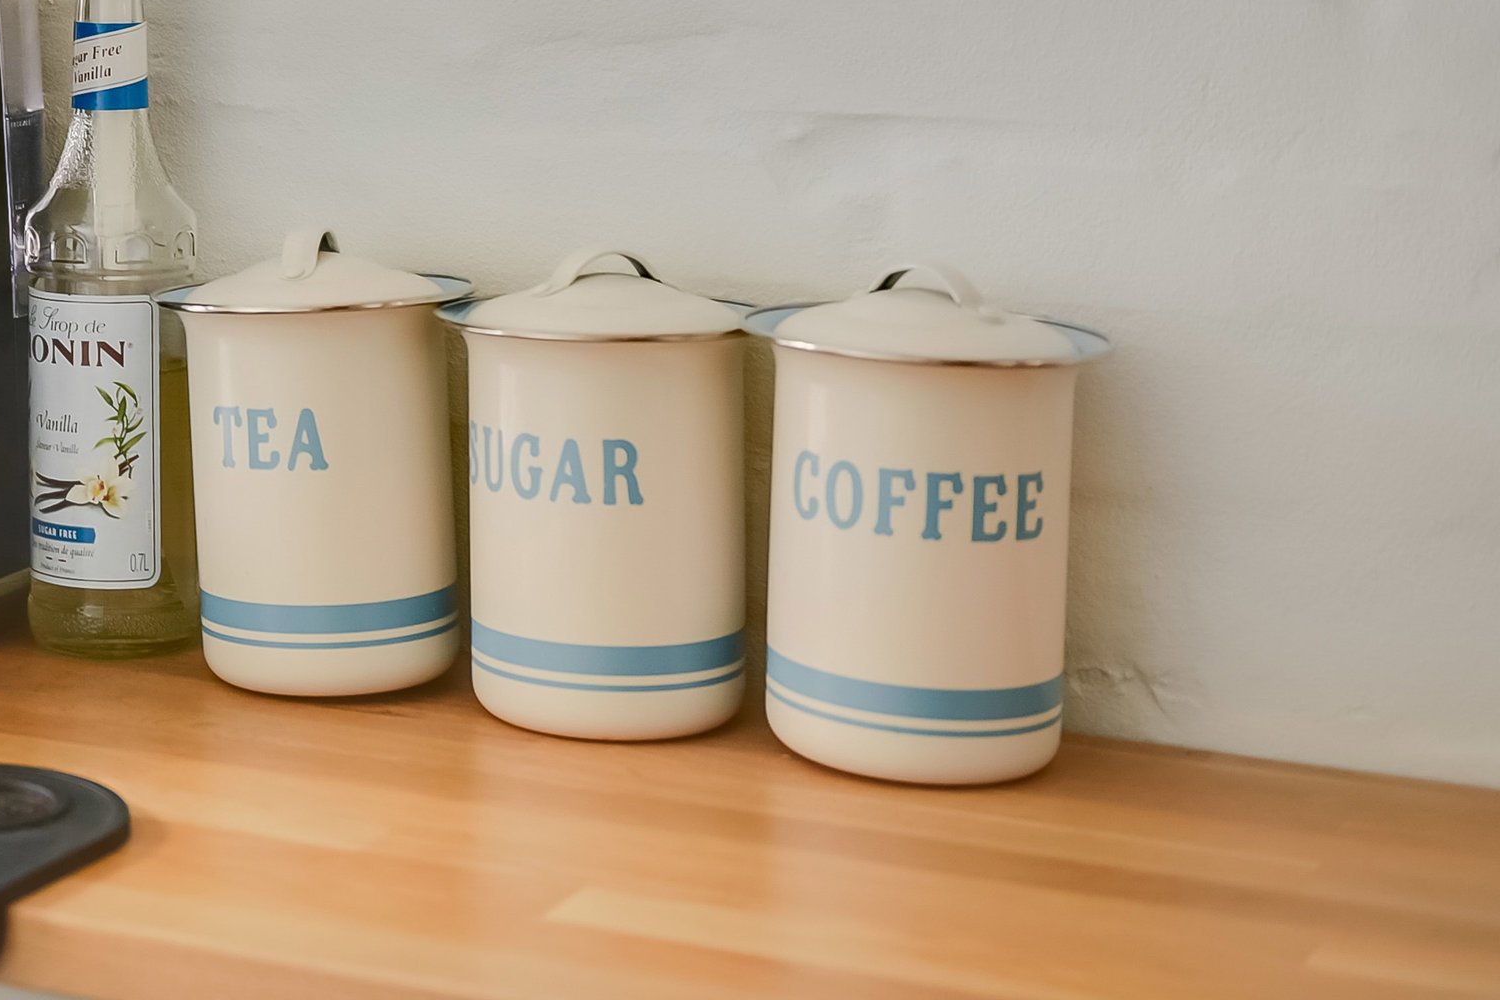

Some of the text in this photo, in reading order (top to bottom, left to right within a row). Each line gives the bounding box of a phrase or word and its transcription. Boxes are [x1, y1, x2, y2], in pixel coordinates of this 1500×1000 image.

[92, 44, 122, 60] Free
[39, 306, 79, 339] Sirop
[84, 319, 106, 334] de
[28, 334, 125, 368] ONIN
[35, 409, 79, 434] Vanilla
[213, 406, 329, 471] TEA
[469, 420, 644, 506] SUGAR
[794, 449, 1044, 543] COFFEE
[38, 524, 78, 540] SUGAR FREE
[130, 553, 150, 573] 0.7L
